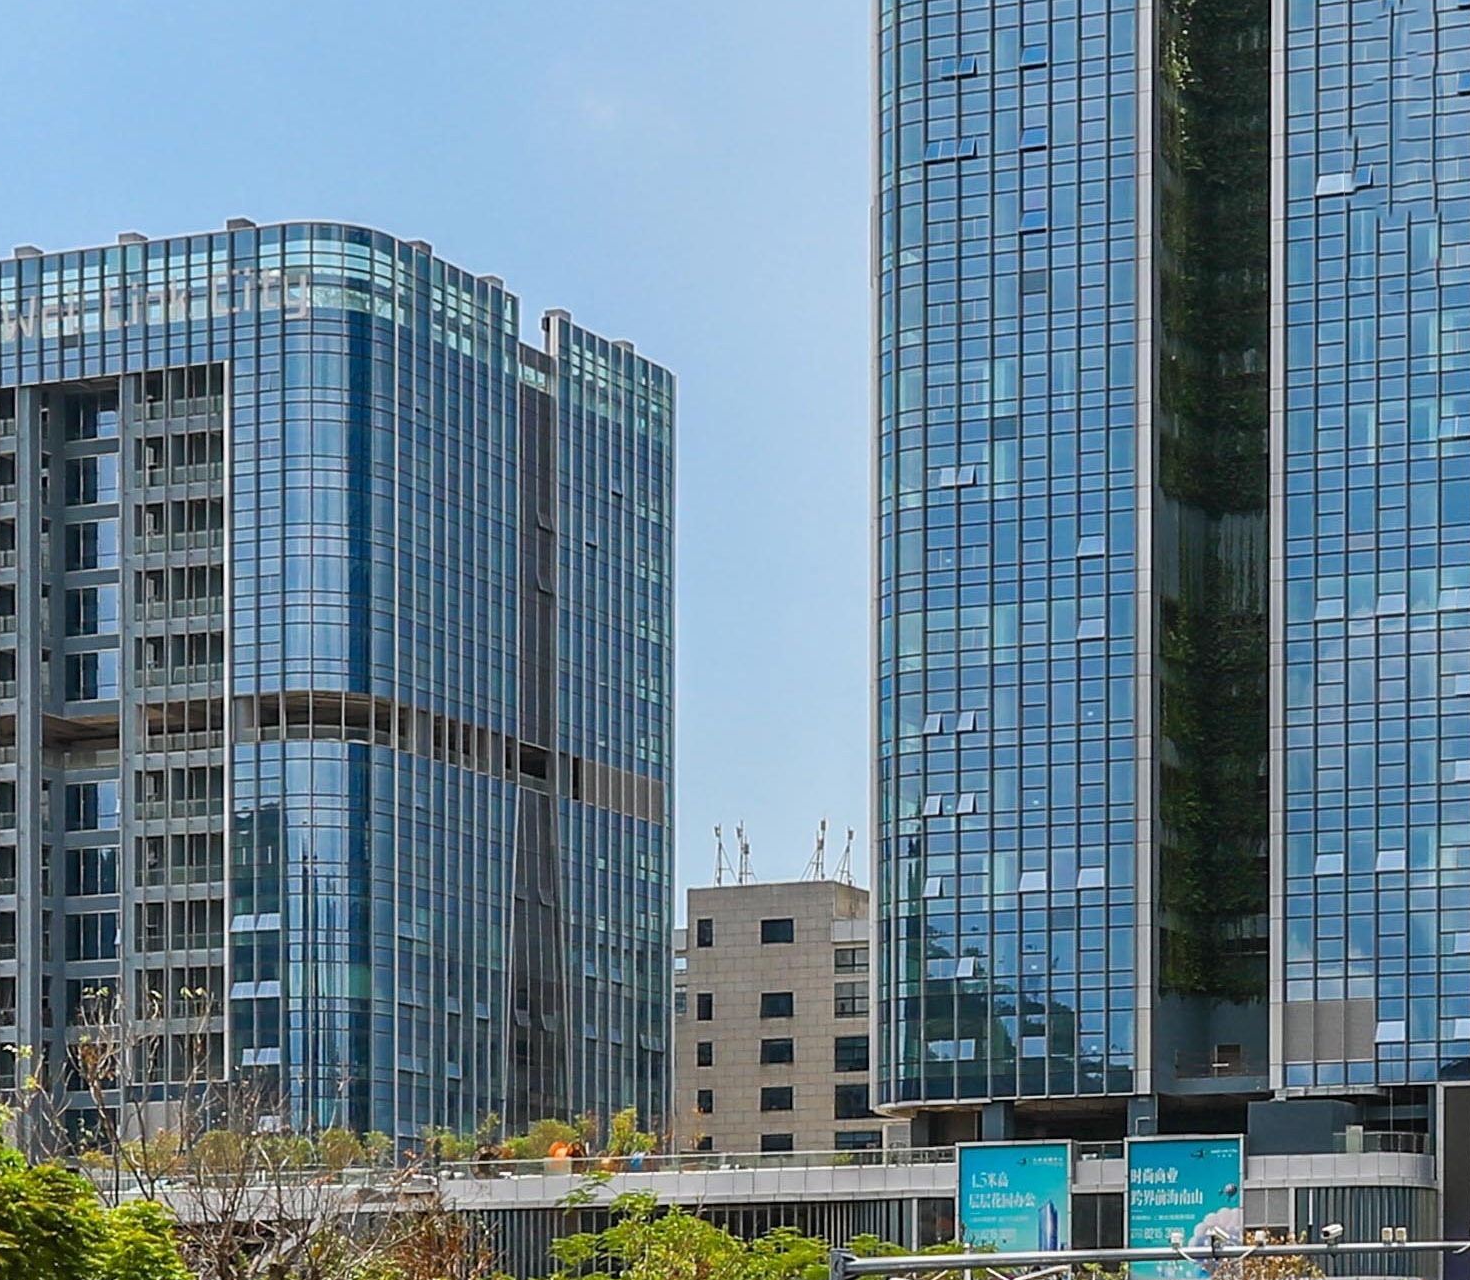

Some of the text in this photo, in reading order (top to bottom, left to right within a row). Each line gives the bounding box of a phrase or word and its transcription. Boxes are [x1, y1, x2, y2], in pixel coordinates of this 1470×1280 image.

[104, 276, 194, 330] Link
[211, 267, 308, 320] City
[1130, 1167, 1178, 1184] 时尚商业
[1130, 1188, 1203, 1206] 跨界前海南山
